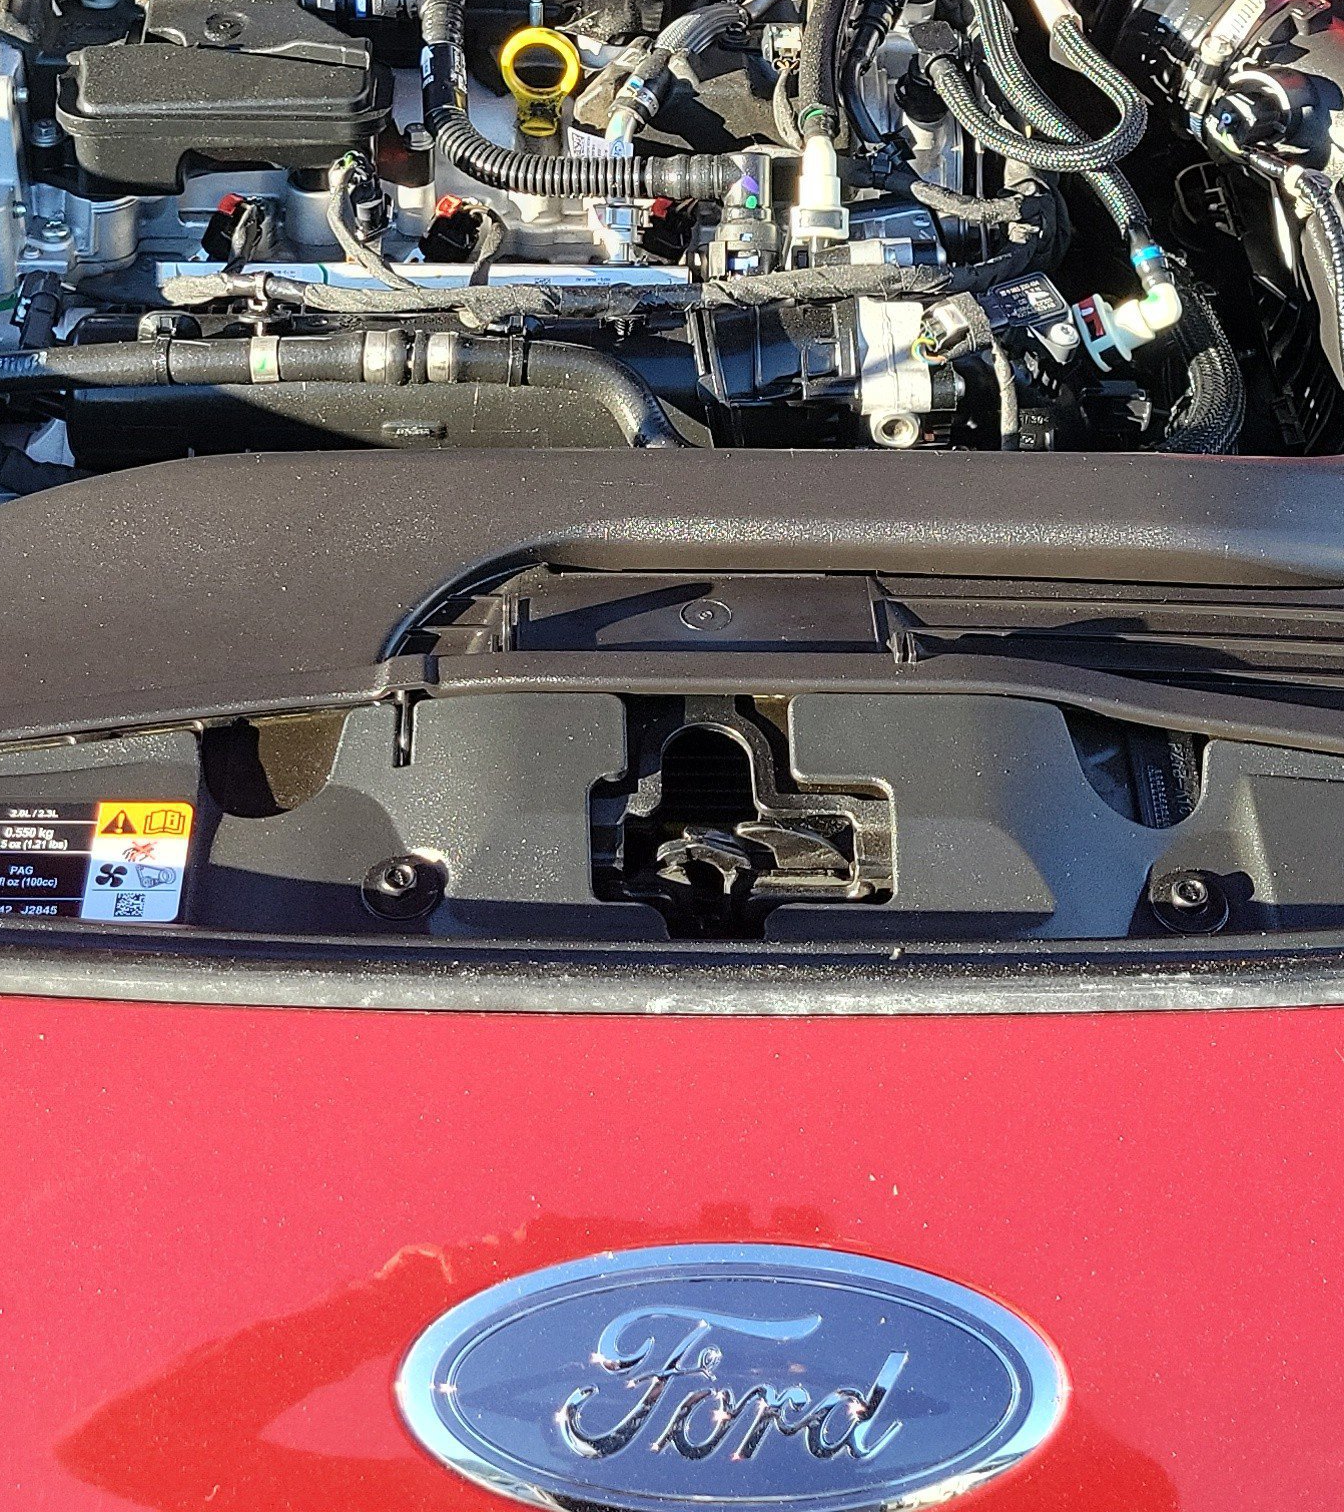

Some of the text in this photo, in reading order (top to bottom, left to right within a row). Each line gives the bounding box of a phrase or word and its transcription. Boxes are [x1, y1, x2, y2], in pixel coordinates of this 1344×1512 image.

[4, 827, 54, 840] 0.550 kg
[9, 841, 22, 849] oz
[9, 865, 34, 875] PAG
[21, 877, 58, 887] (100cc)
[20, 905, 58, 915] J2845
[556, 1305, 910, 1461] Ford
